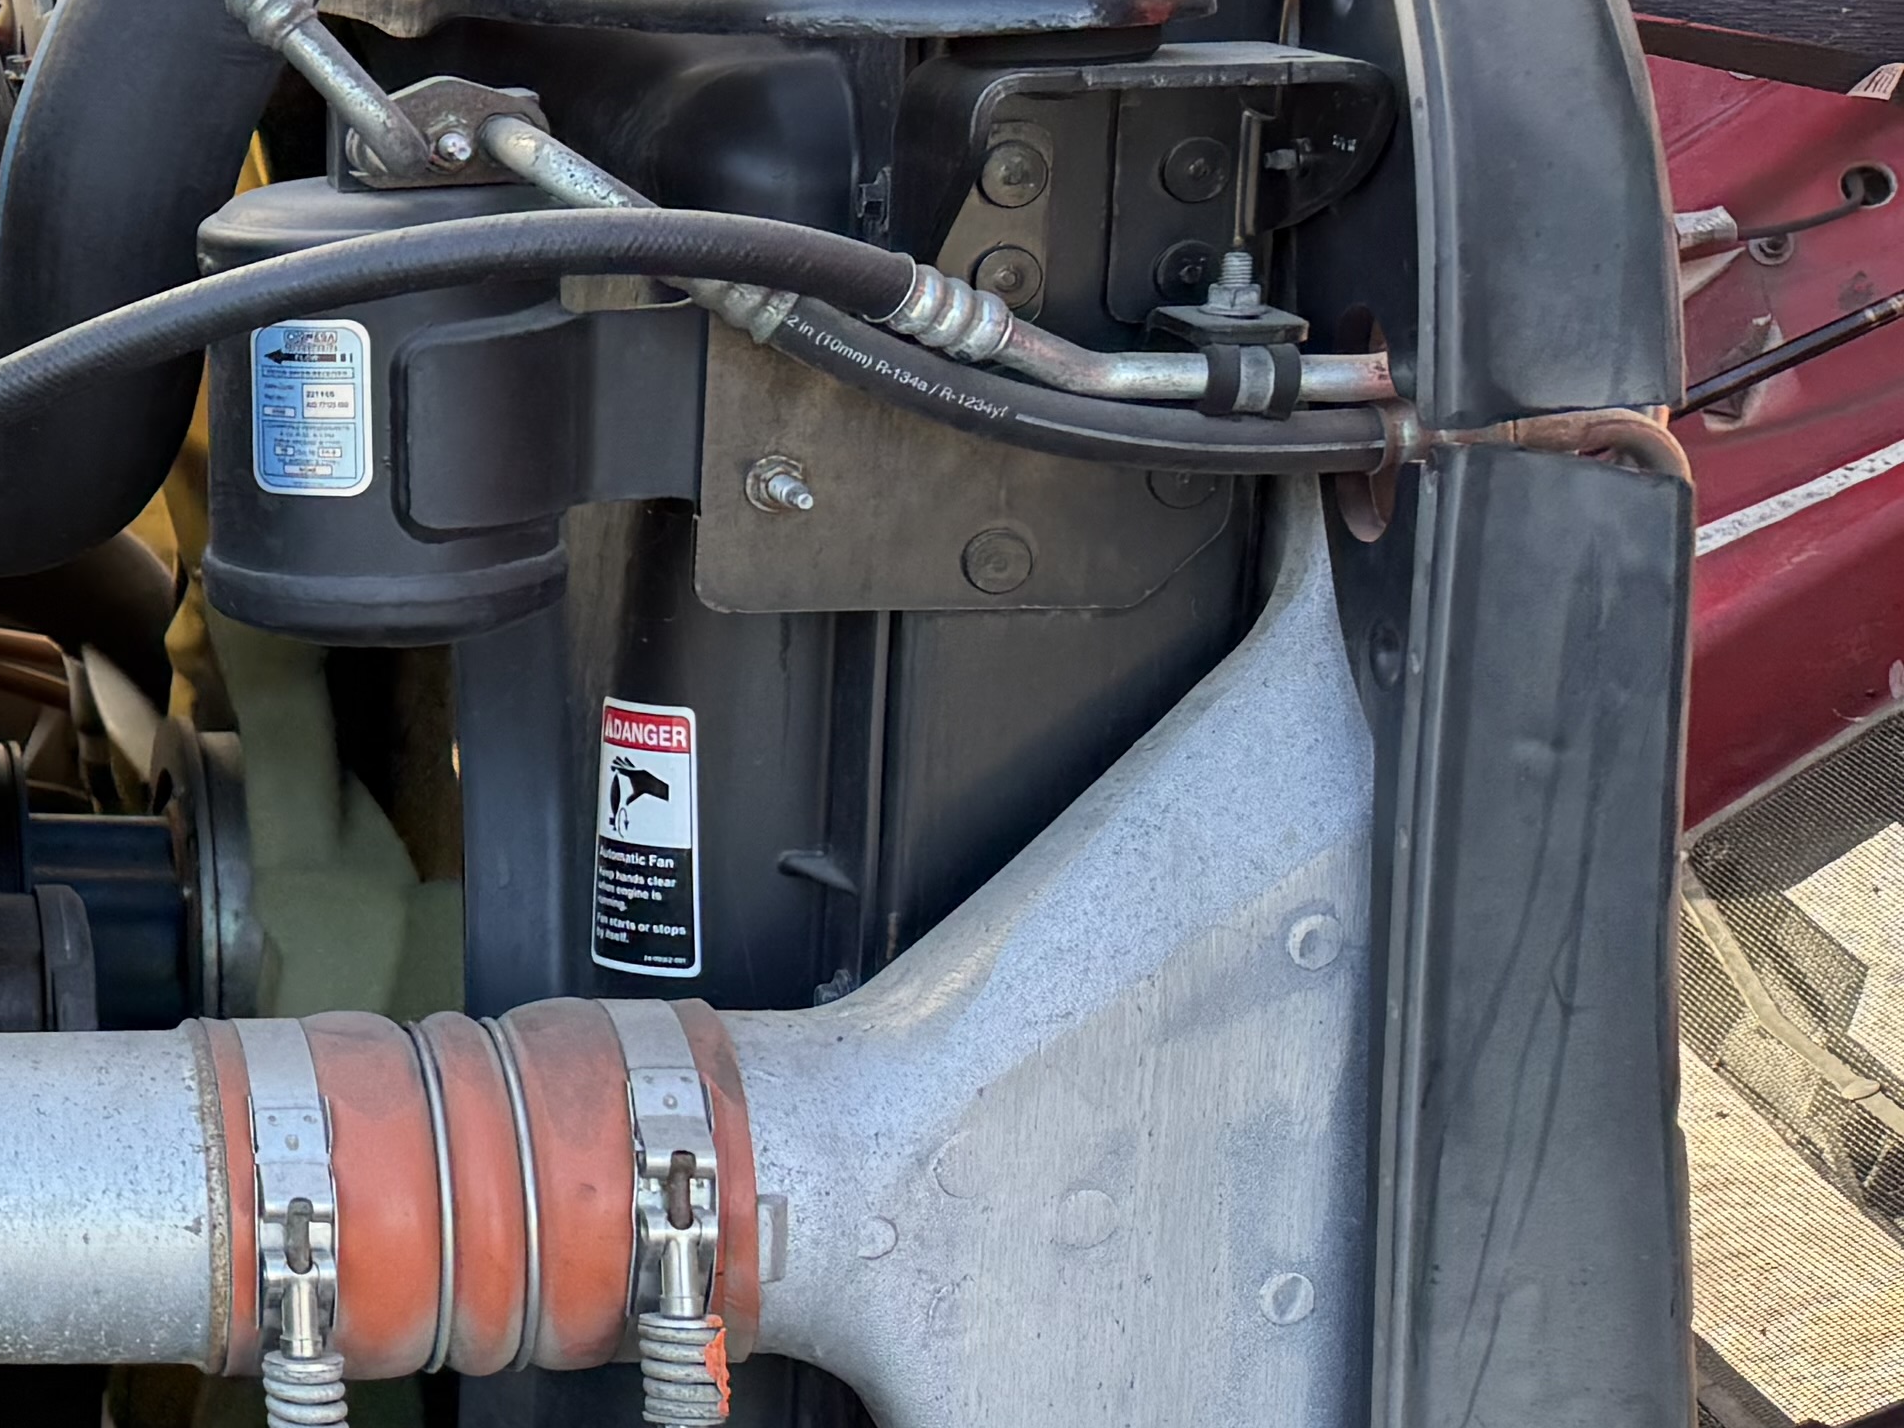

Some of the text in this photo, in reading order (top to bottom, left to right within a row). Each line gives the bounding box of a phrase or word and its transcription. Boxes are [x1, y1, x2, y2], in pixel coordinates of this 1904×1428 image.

[799, 321, 814, 338] in
[815, 330, 874, 369] (10mm)
[876, 358, 928, 394] R-134a
[941, 384, 1009, 419] R-1234yf
[612, 718, 687, 749] DANGER
[600, 844, 675, 869] Automatic Fan
[615, 870, 645, 885] hands
[646, 875, 678, 888] clear
[616, 886, 649, 900] engine
[609, 916, 636, 931] starts
[637, 922, 650, 933] or
[652, 924, 687, 938] stops
